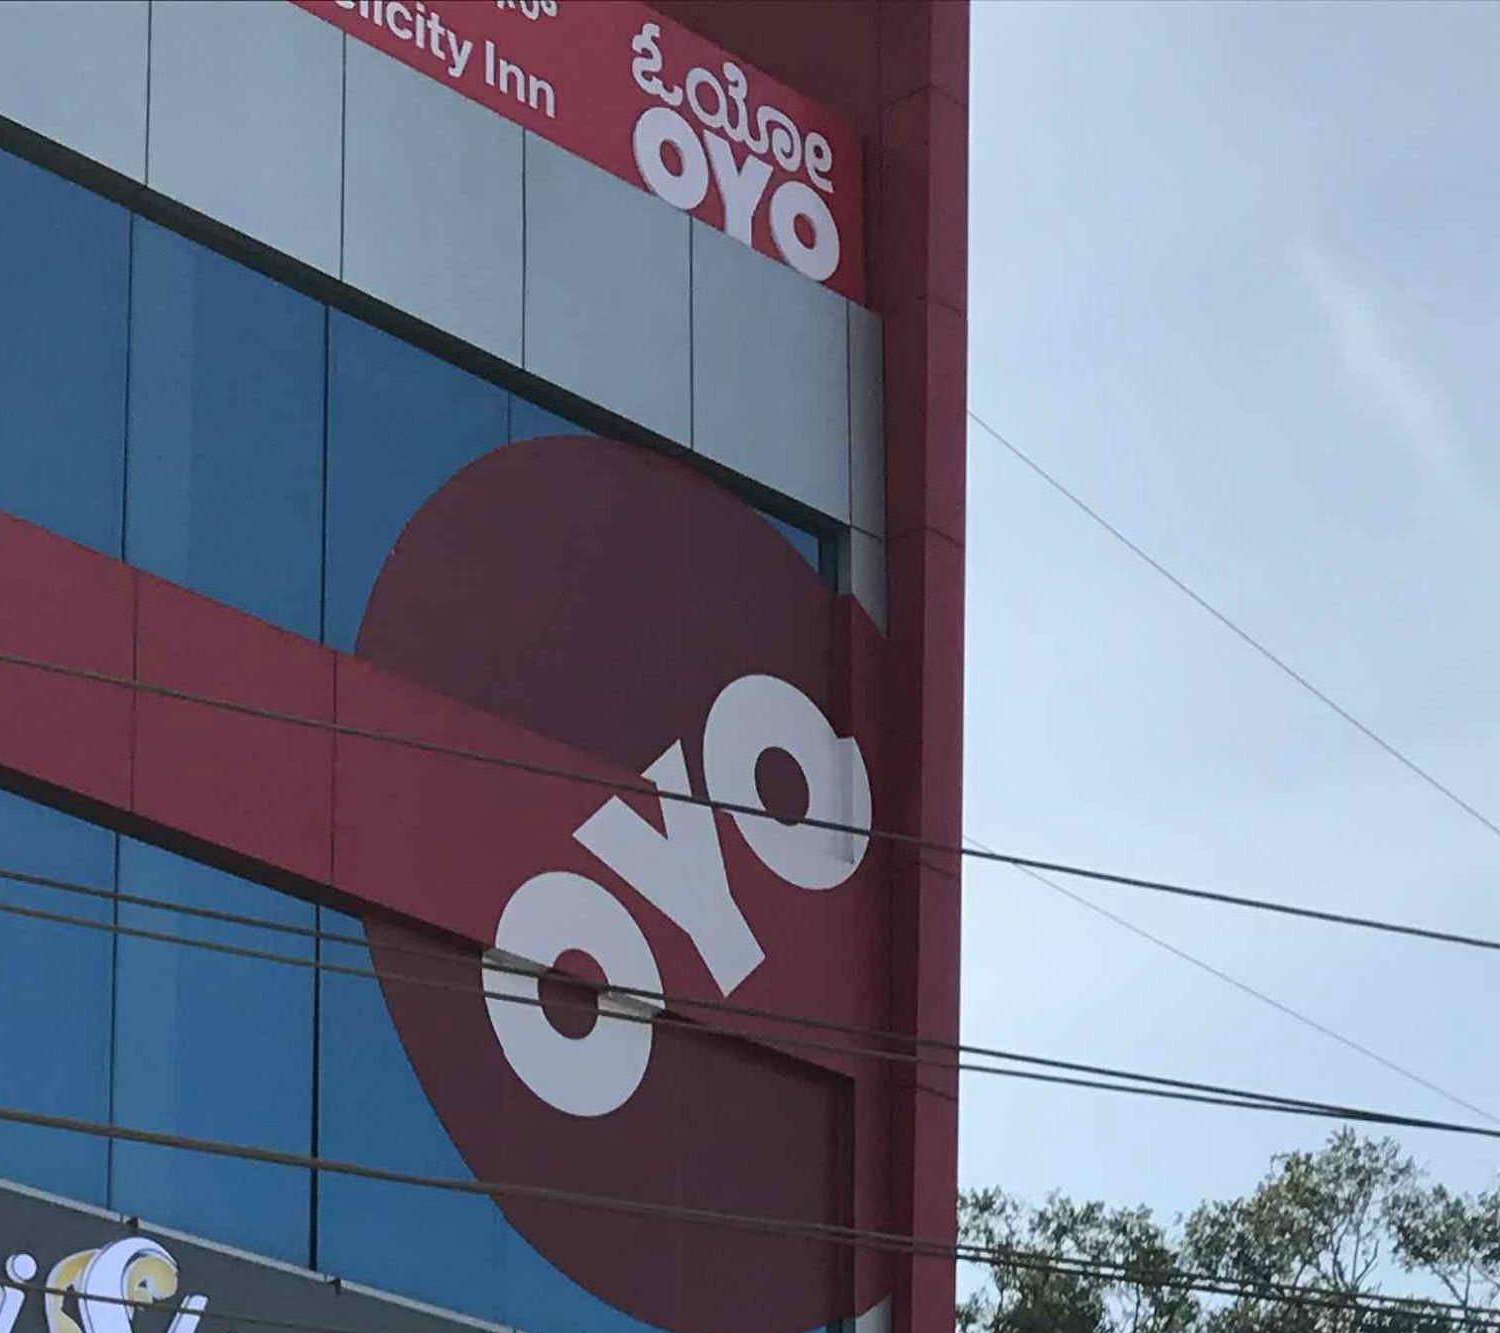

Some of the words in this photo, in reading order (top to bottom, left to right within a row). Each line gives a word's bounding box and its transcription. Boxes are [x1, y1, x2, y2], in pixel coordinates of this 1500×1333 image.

[335, 0, 474, 78] icity
[485, 40, 556, 119] Inn
[633, 107, 840, 281] OYO
[482, 673, 873, 1117] OYO
